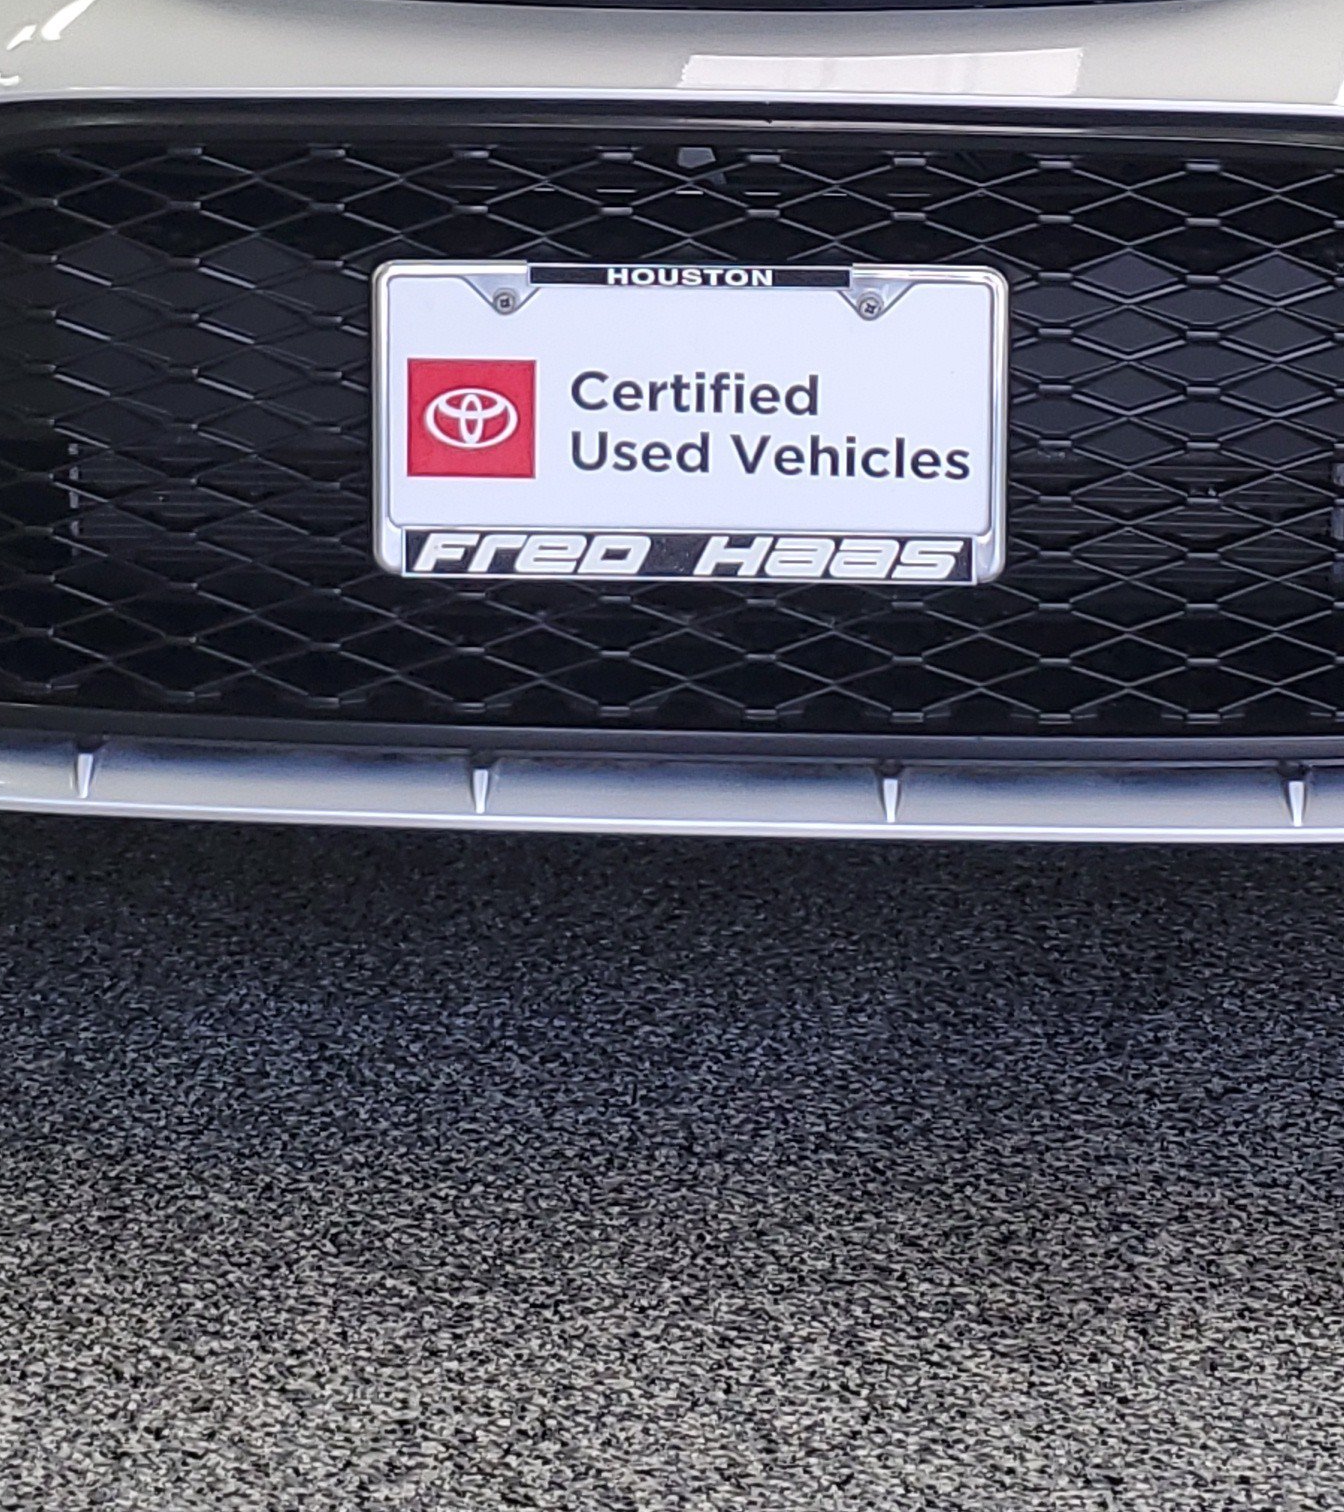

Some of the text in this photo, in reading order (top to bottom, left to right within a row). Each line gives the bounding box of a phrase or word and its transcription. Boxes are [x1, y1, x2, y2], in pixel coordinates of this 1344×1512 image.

[607, 267, 773, 287] HOUSTON
[571, 370, 820, 416] Certified
[571, 431, 971, 480] Used Vehicles
